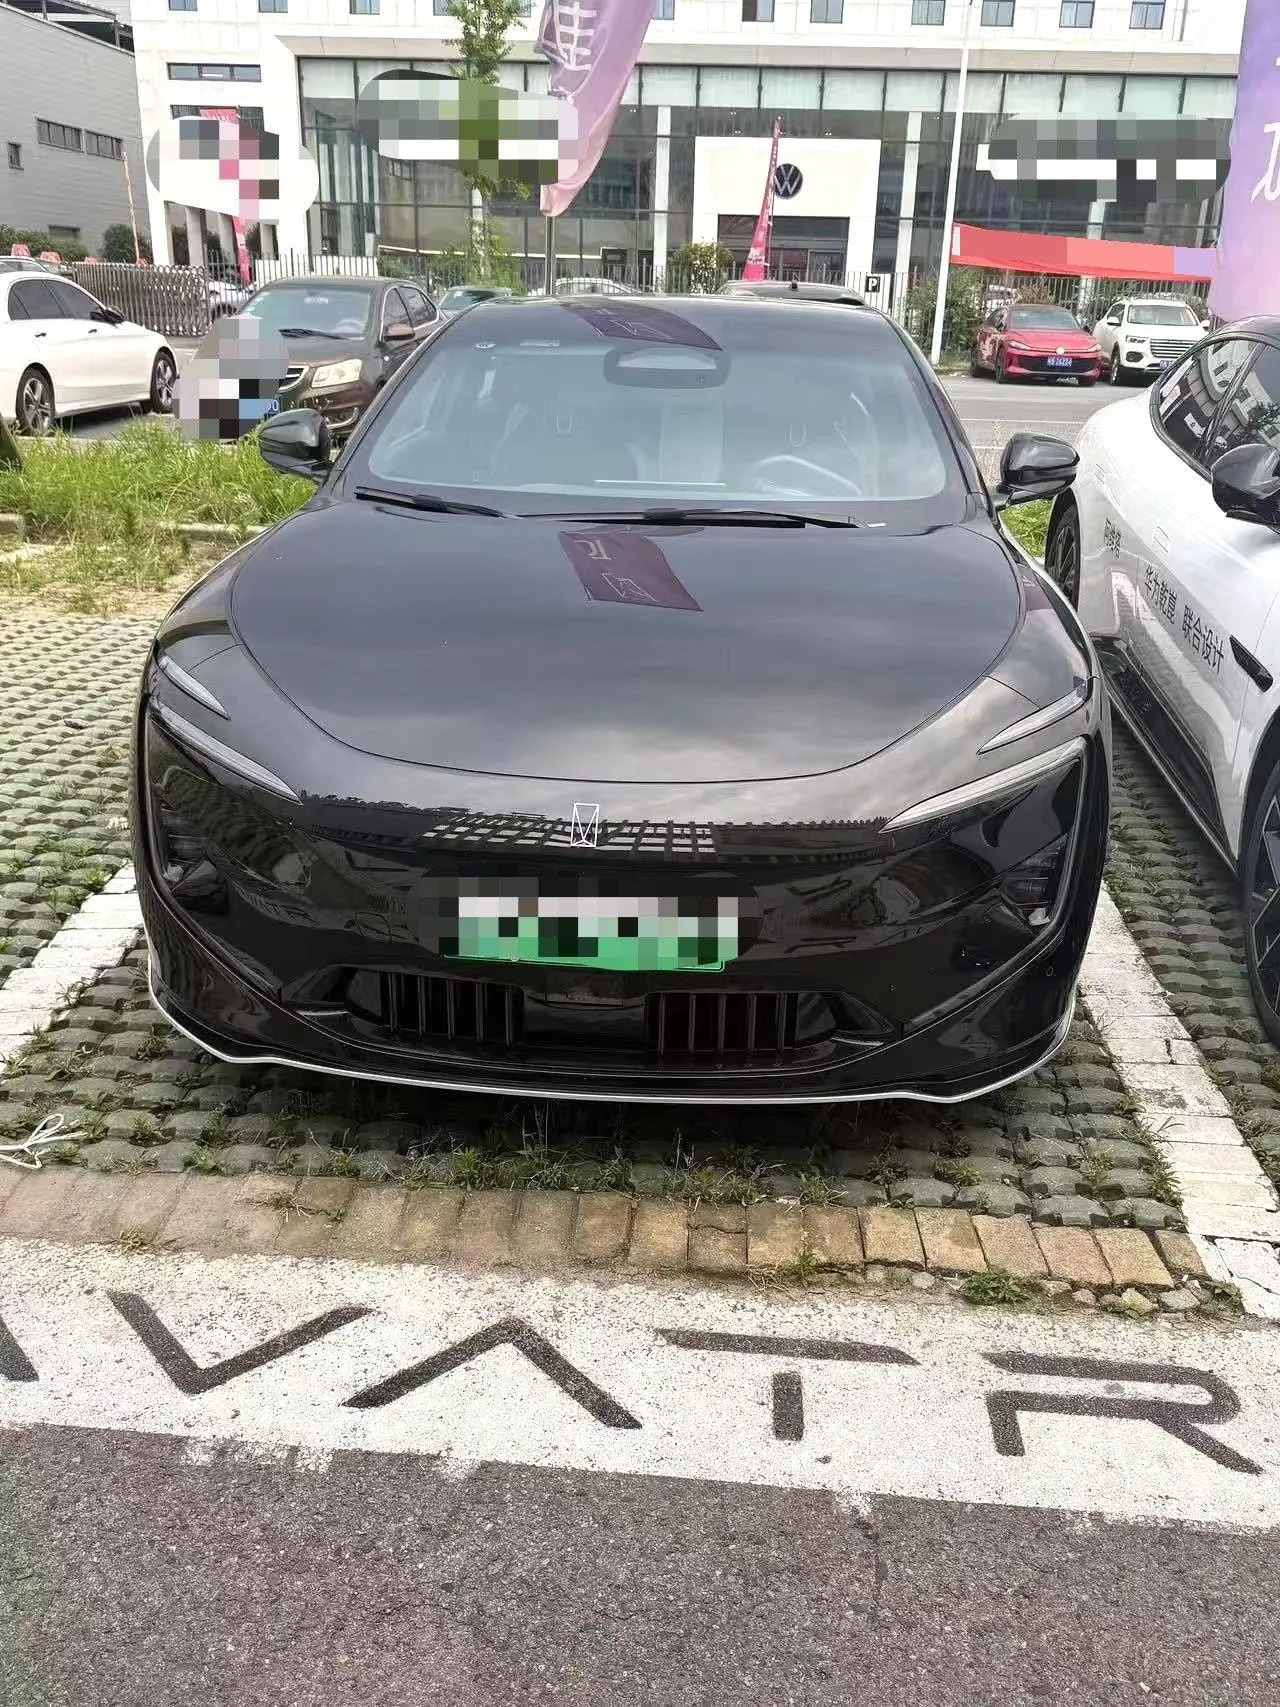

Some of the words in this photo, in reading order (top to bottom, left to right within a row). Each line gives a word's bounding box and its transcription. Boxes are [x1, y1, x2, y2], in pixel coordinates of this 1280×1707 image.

[774, 163, 803, 198] VW
[867, 277, 878, 291] P
[1182, 604, 1225, 675] 联合设计
[0, 1290, 1263, 1476] VATR
